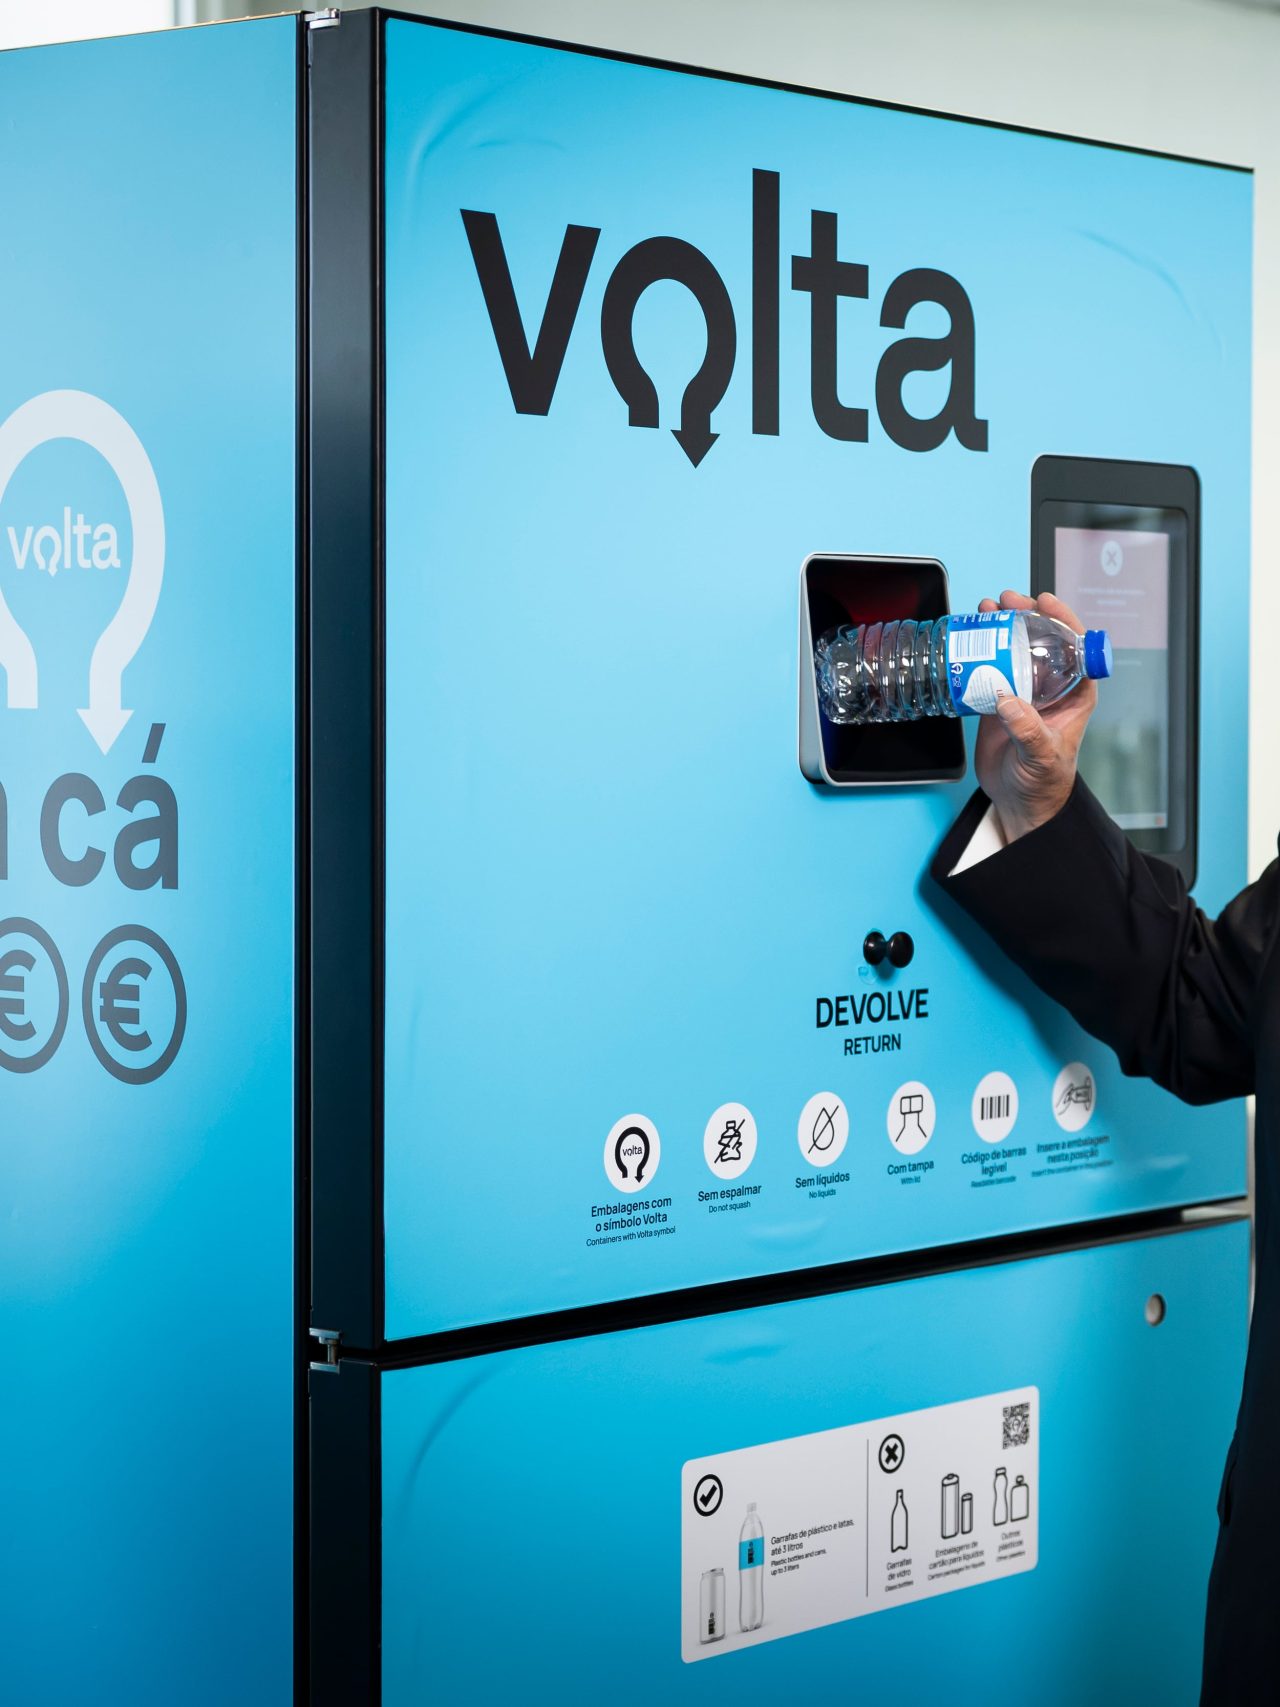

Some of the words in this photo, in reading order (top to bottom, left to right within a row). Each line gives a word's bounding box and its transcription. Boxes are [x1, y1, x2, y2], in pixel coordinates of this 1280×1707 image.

[460, 168, 989, 468] volta
[7, 506, 121, 577] volta
[40, 723, 178, 890] cá
[816, 988, 929, 1028] DEVOLVE
[844, 1033, 901, 1056] RETURN
[622, 1145, 643, 1157] volta
[962, 1151, 990, 1165] Código
[991, 1149, 1001, 1160] de
[1002, 1147, 1027, 1159] barras
[887, 1164, 907, 1175] Com
[908, 1160, 935, 1174] tampa
[981, 1162, 1007, 1177] legível
[795, 1177, 815, 1188] Sem
[816, 1172, 850, 1187] líquidos
[698, 1190, 718, 1202] Sem
[720, 1184, 762, 1201] espalmar
[809, 1191, 817, 1199] No
[818, 1188, 836, 1198] liquids
[591, 1199, 650, 1218] Embalagens
[651, 1197, 672, 1209] com
[708, 1205, 717, 1213] Do
[718, 1204, 728, 1212] not
[729, 1201, 751, 1212] squash
[595, 1222, 601, 1232] o
[603, 1214, 641, 1232] símbolo
[643, 1212, 668, 1226] Volta
[586, 1234, 622, 1246] Containers
[622, 1231, 636, 1241] with
[636, 1229, 653, 1239] Volta
[653, 1226, 676, 1239] symbol
[771, 1532, 798, 1545] Garrafas
[799, 1530, 807, 1538] de
[808, 1524, 832, 1538] plástico
[771, 1546, 781, 1556] até
[787, 1542, 803, 1552] litros
